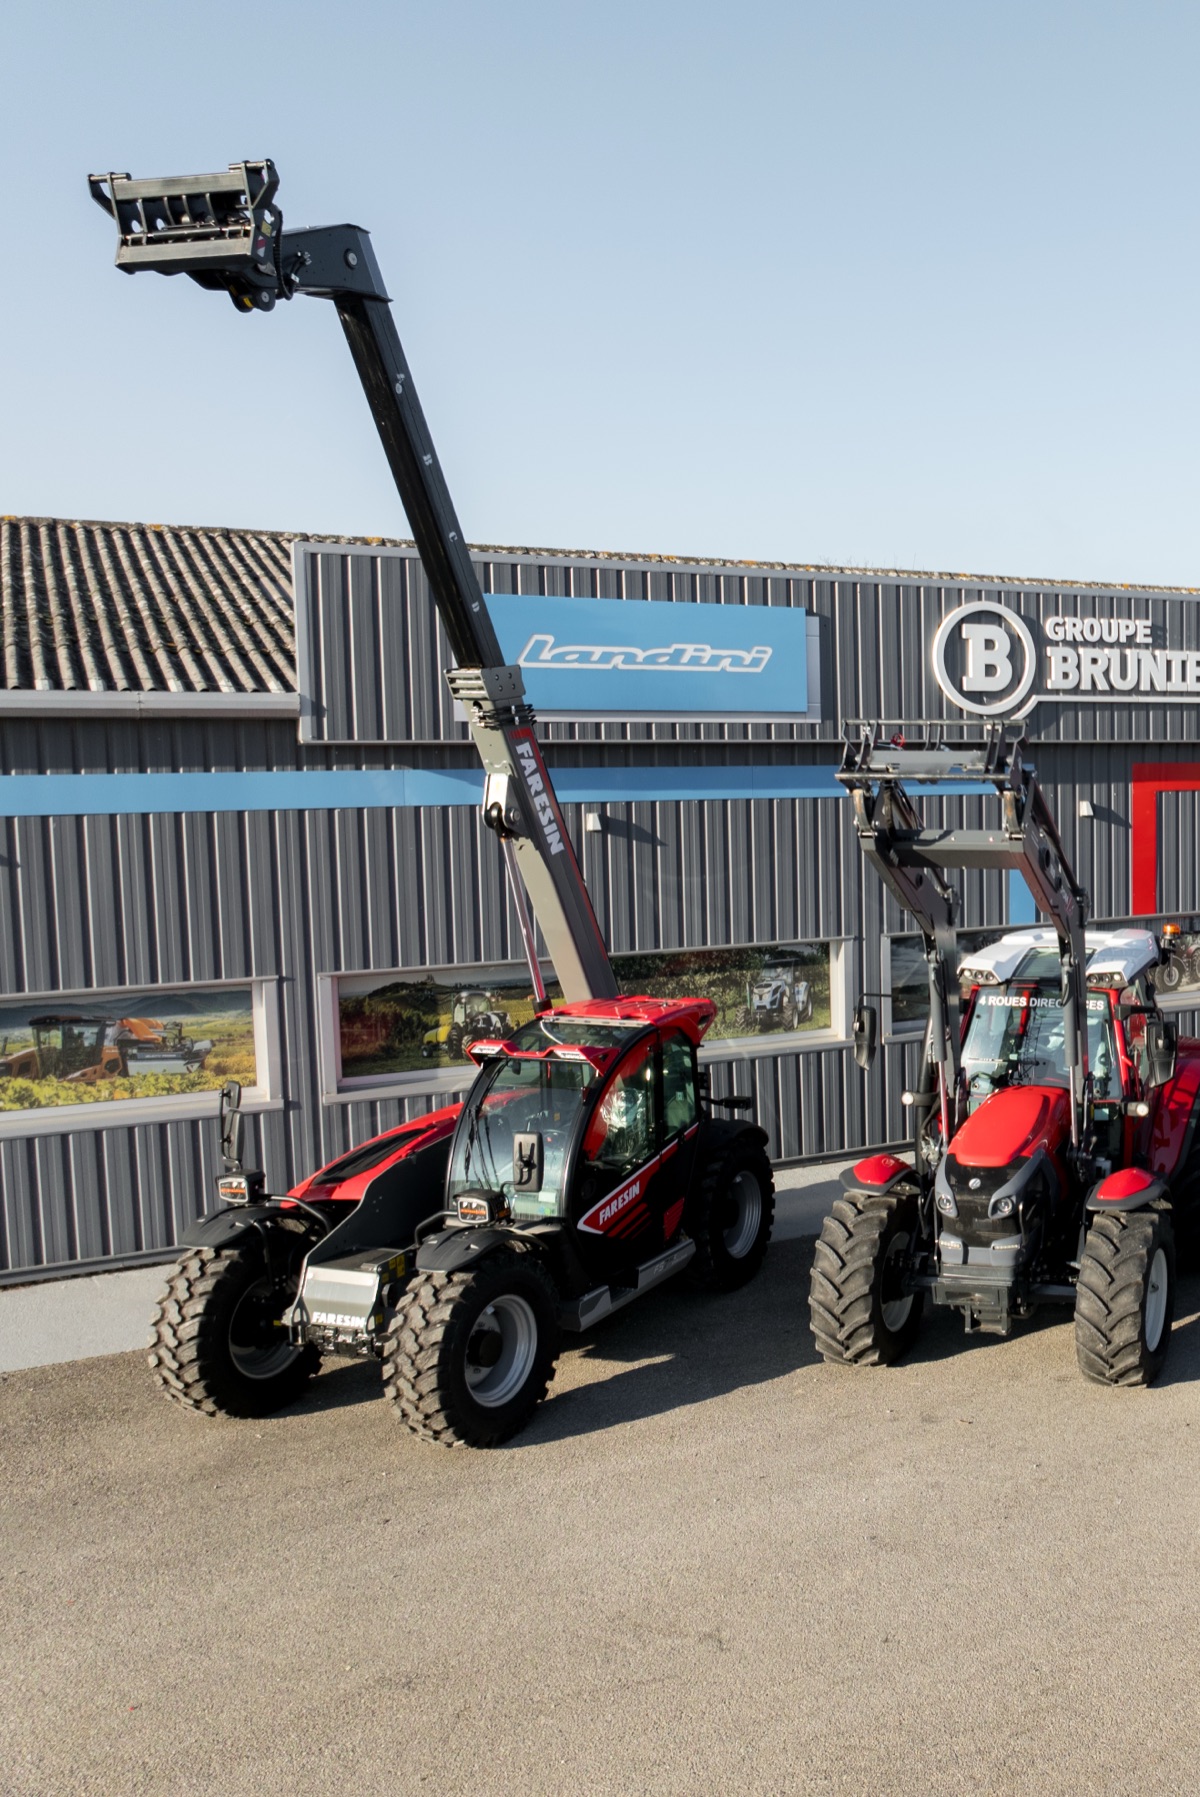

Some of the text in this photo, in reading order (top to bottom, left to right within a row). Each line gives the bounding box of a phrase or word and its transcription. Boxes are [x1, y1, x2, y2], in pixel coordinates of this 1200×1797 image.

[1045, 616, 1153, 644] GROUPE
[517, 634, 773, 673] Landini
[961, 623, 1013, 692] B
[515, 741, 565, 856] FARESIN
[979, 995, 986, 1005] 4
[988, 996, 1027, 1007] ROUES
[599, 1180, 640, 1226] FARESIN
[311, 1311, 366, 1328] FARESIN
